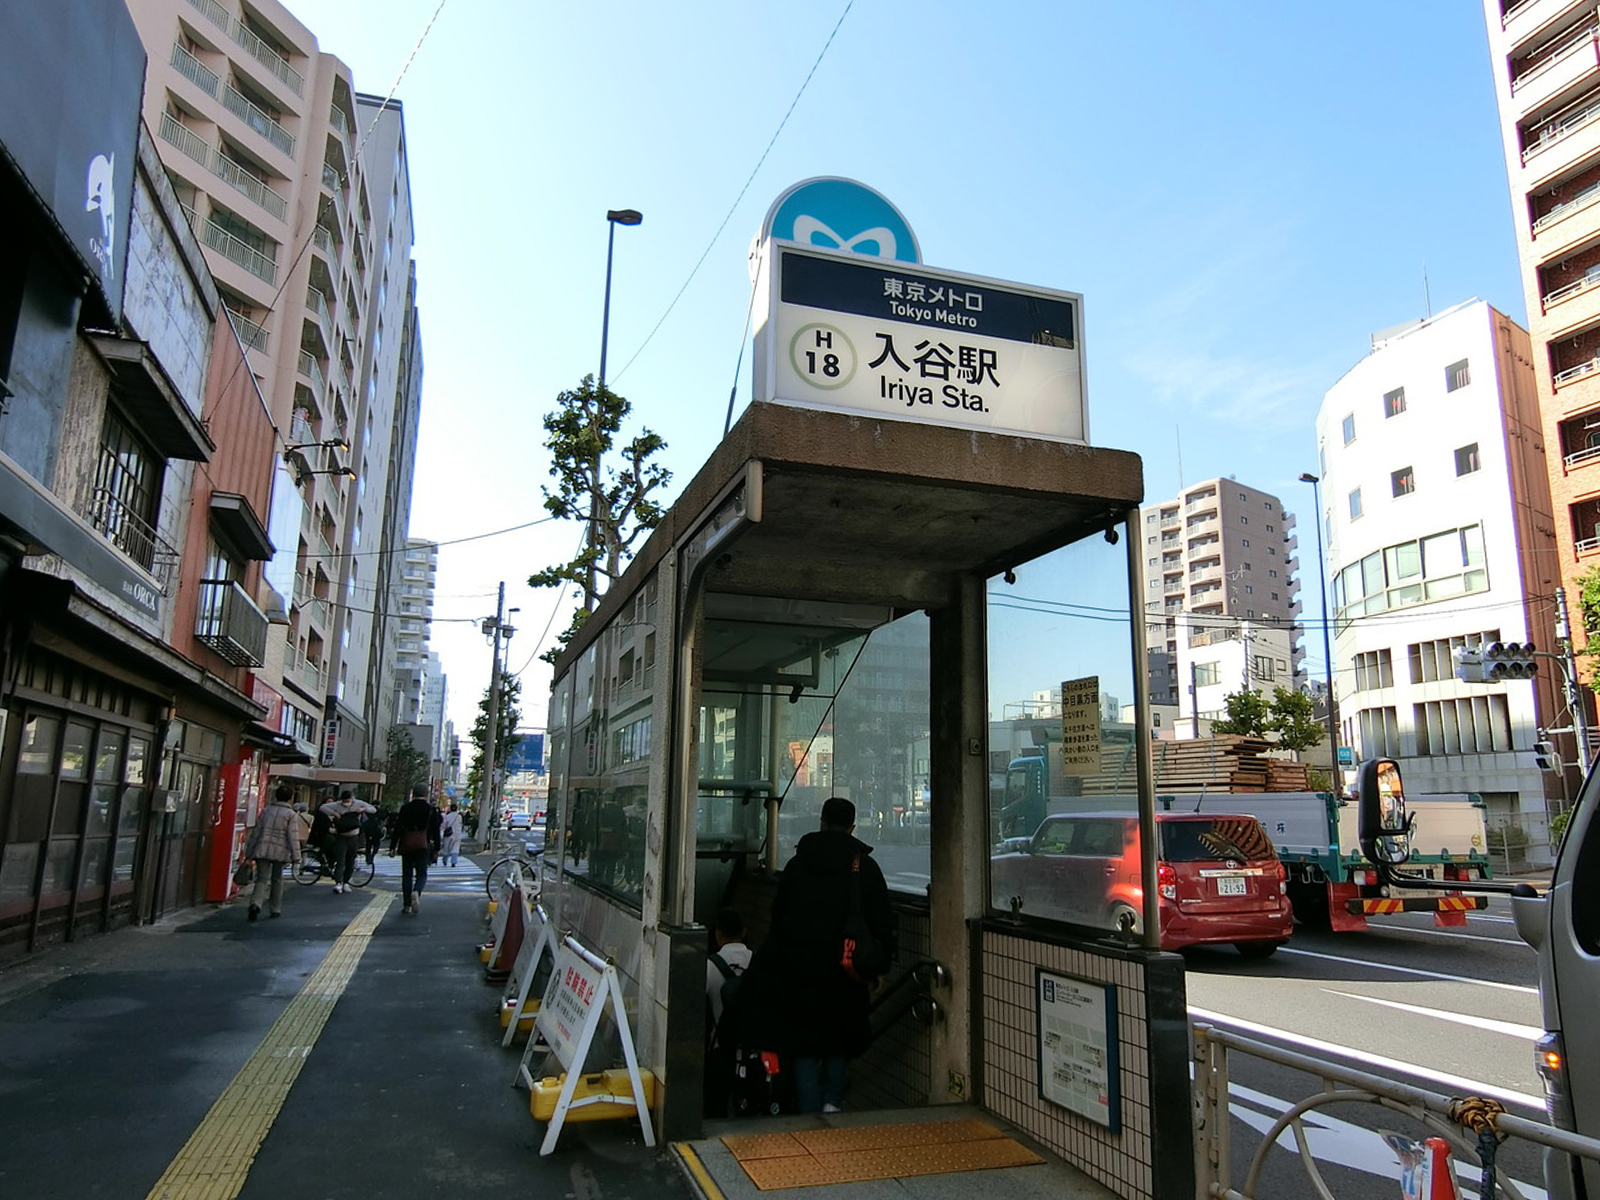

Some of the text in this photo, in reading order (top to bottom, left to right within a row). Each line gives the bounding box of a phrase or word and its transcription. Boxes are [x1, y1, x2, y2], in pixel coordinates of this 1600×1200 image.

[882, 277, 983, 312] 東京メトロ
[889, 300, 977, 328] Tokyo Metro
[815, 330, 832, 349] H
[805, 351, 840, 377] 18
[868, 332, 1001, 388] 入谷駅
[880, 375, 990, 413] Iriya Sta.
[133, 583, 156, 611] ORCA
[1063, 692, 1098, 707] 中目黒方面
[565, 967, 594, 1005] 駐輪禁止
